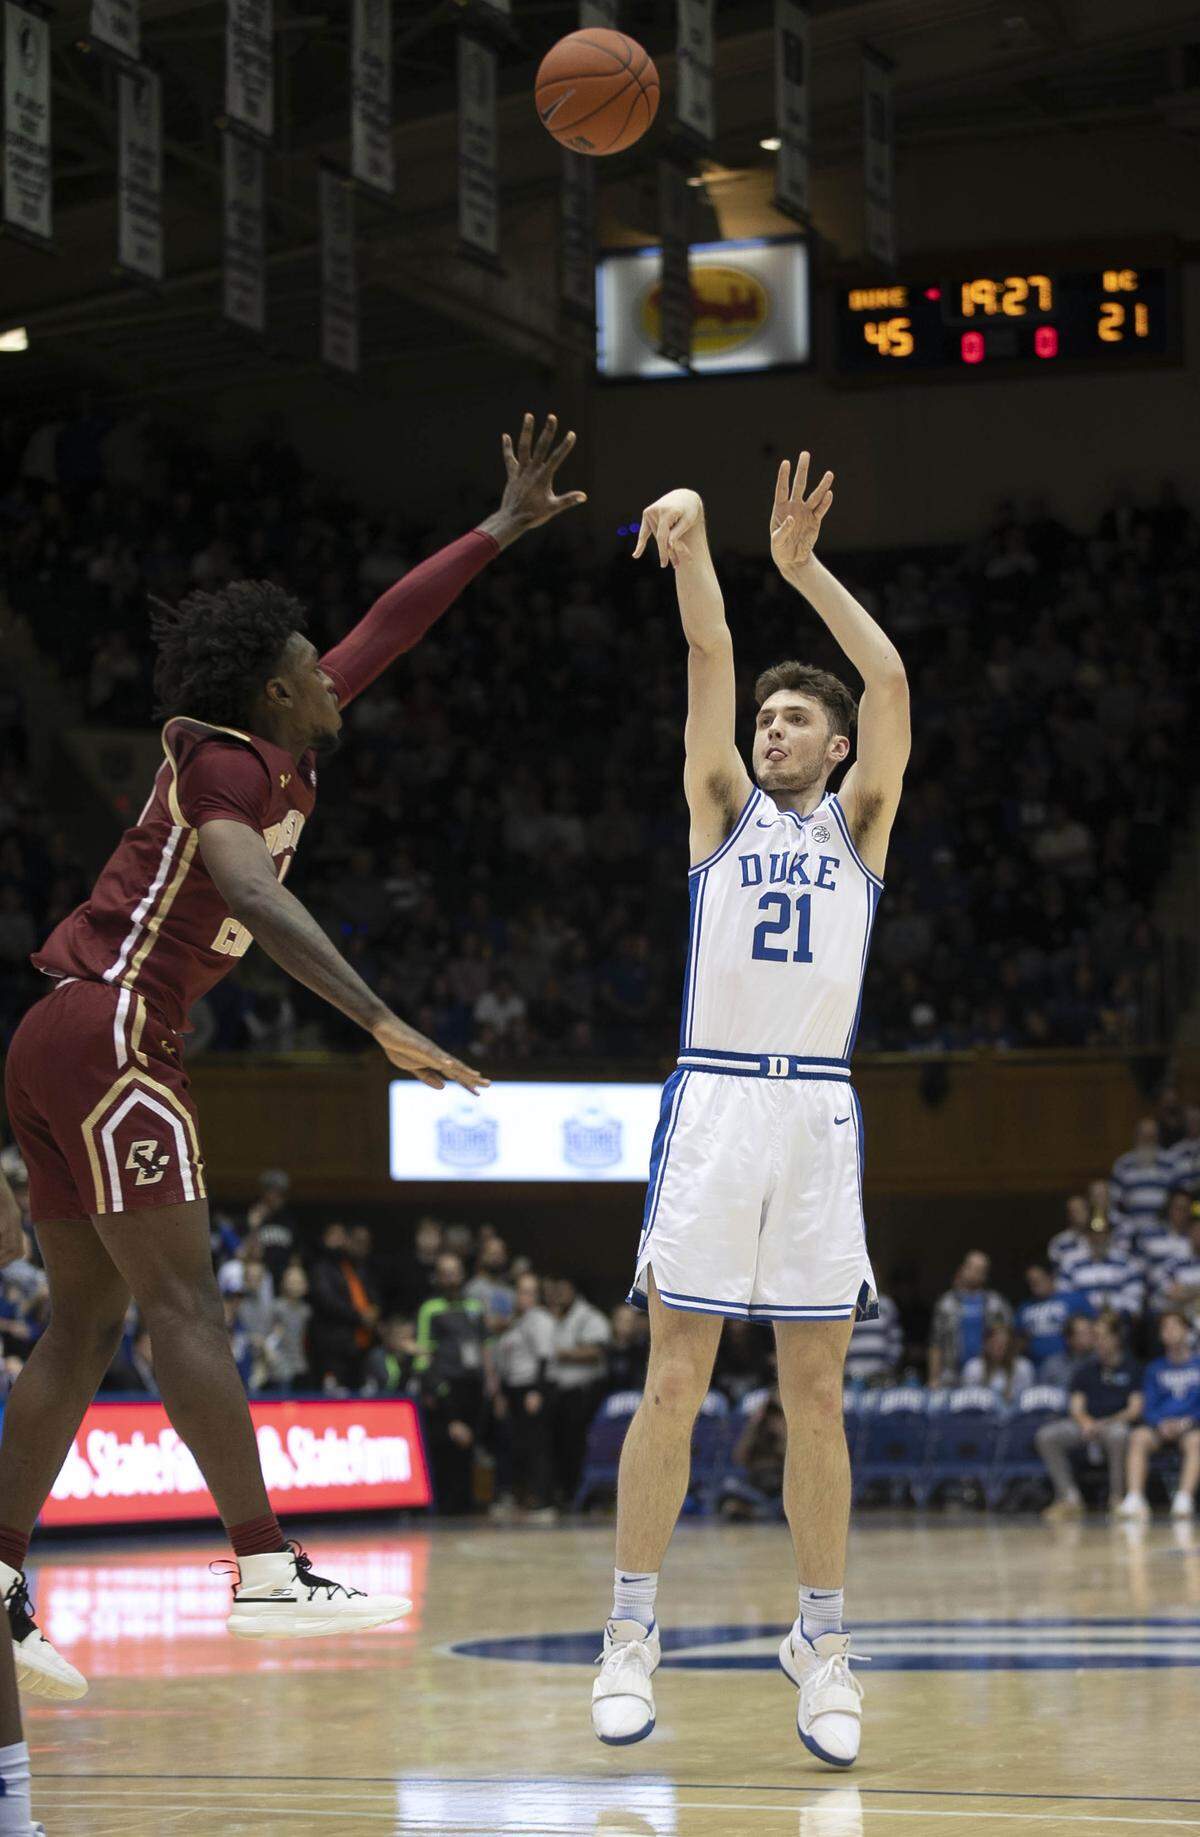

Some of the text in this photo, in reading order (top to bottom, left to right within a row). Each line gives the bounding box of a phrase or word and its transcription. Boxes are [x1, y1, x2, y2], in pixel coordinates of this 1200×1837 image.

[864, 317, 914, 357] 45
[1098, 302, 1148, 342] 21
[738, 851, 841, 891] DUKE
[752, 891, 814, 963] 21
[767, 1056, 790, 1077] D
